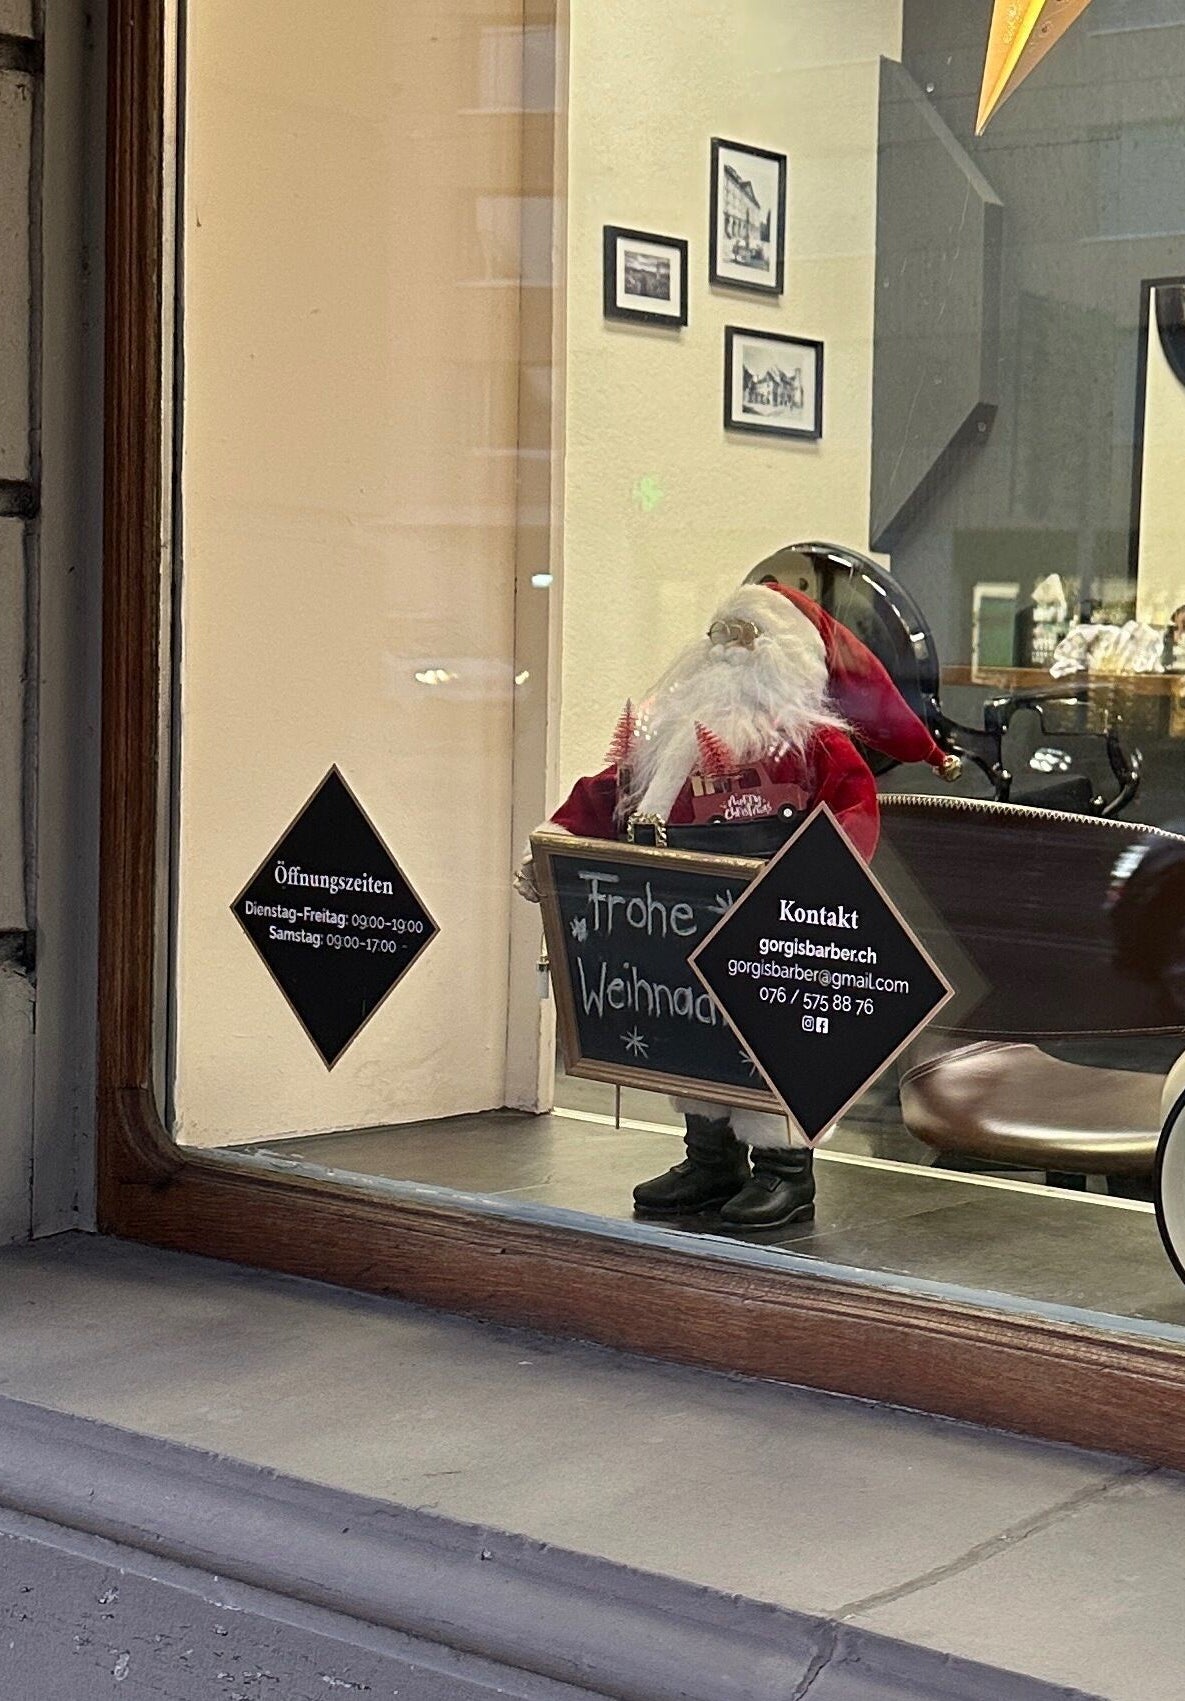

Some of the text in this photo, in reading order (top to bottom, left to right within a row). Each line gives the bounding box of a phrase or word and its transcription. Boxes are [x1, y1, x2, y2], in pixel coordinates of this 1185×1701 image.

[274, 860, 394, 895] Öffnungszeiten
[578, 870, 697, 938] Frohe
[779, 899, 859, 930] Kontakt
[268, 925, 324, 948] Samstag:
[759, 937, 877, 964] gorgisbarber.ch
[728, 958, 909, 994] gorgisbarber@gmail.com
[759, 986, 787, 1004] 076
[802, 992, 829, 1012] 575
[832, 994, 851, 1012] 88
[855, 998, 874, 1016] 76
